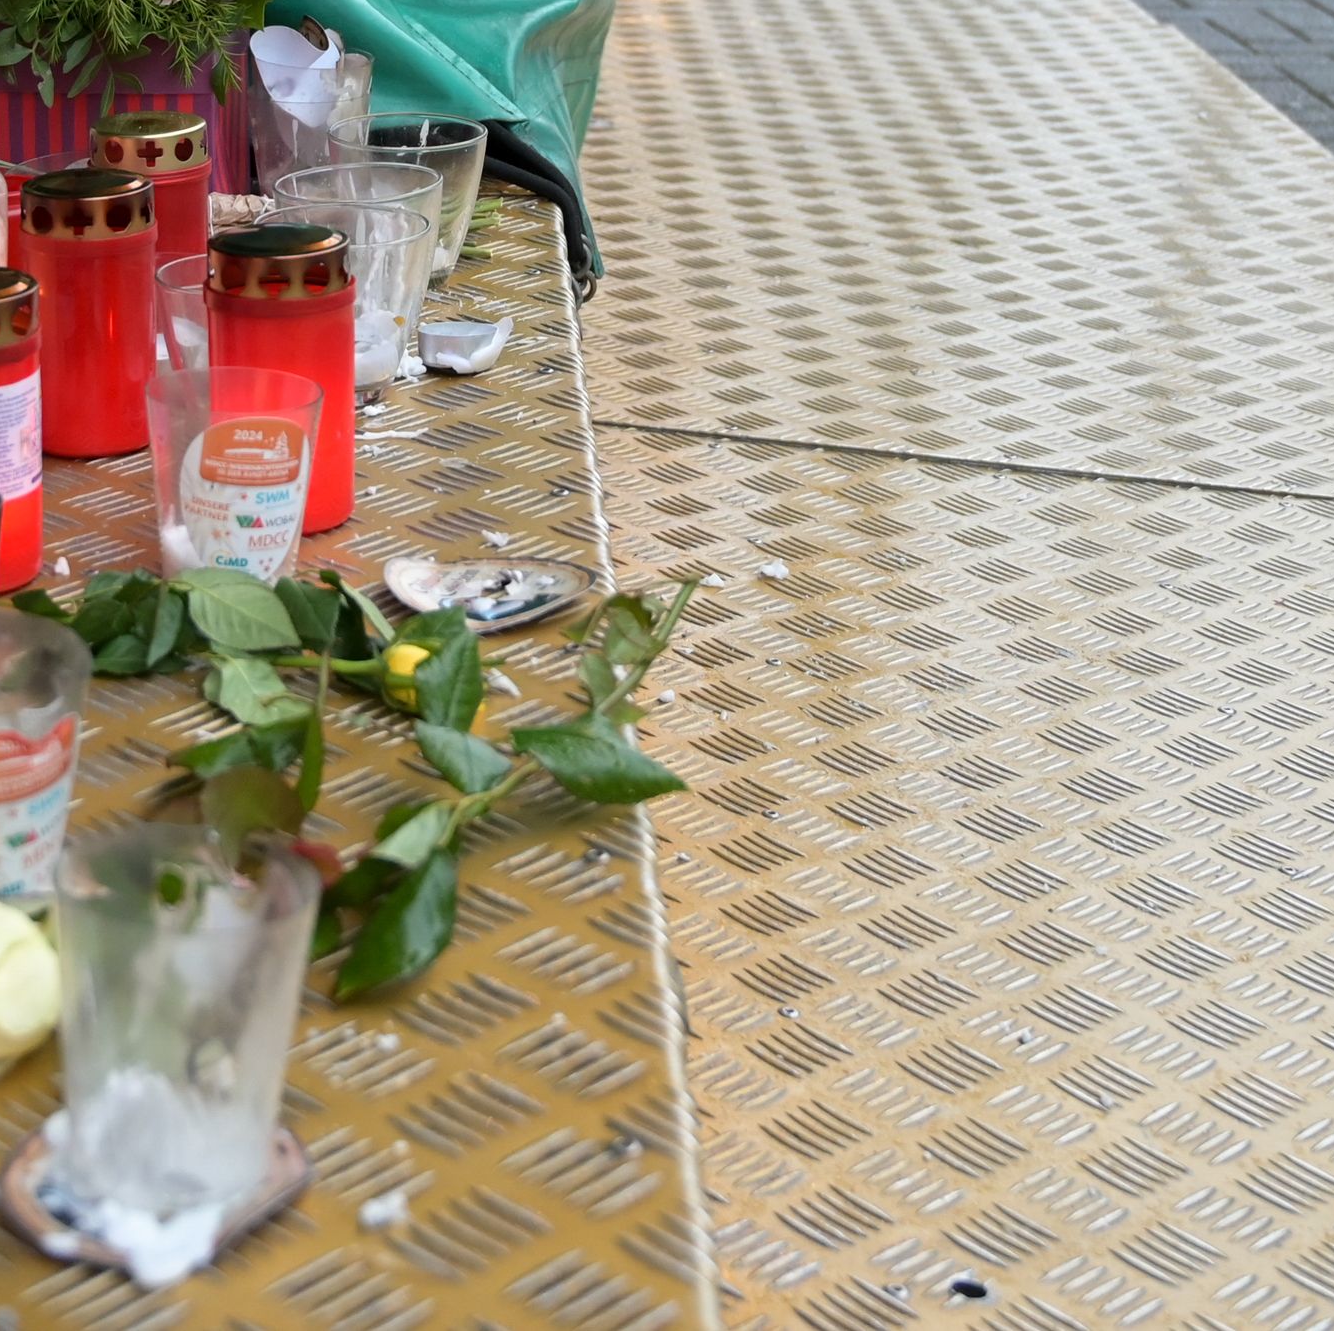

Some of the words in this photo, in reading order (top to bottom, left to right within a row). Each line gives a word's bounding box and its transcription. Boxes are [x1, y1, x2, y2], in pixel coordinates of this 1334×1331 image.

[234, 429, 263, 440] 2024
[192, 496, 229, 511] UNSERE
[256, 490, 289, 504] SWM
[185, 503, 228, 522] PARTNER
[249, 531, 288, 547] MDCC
